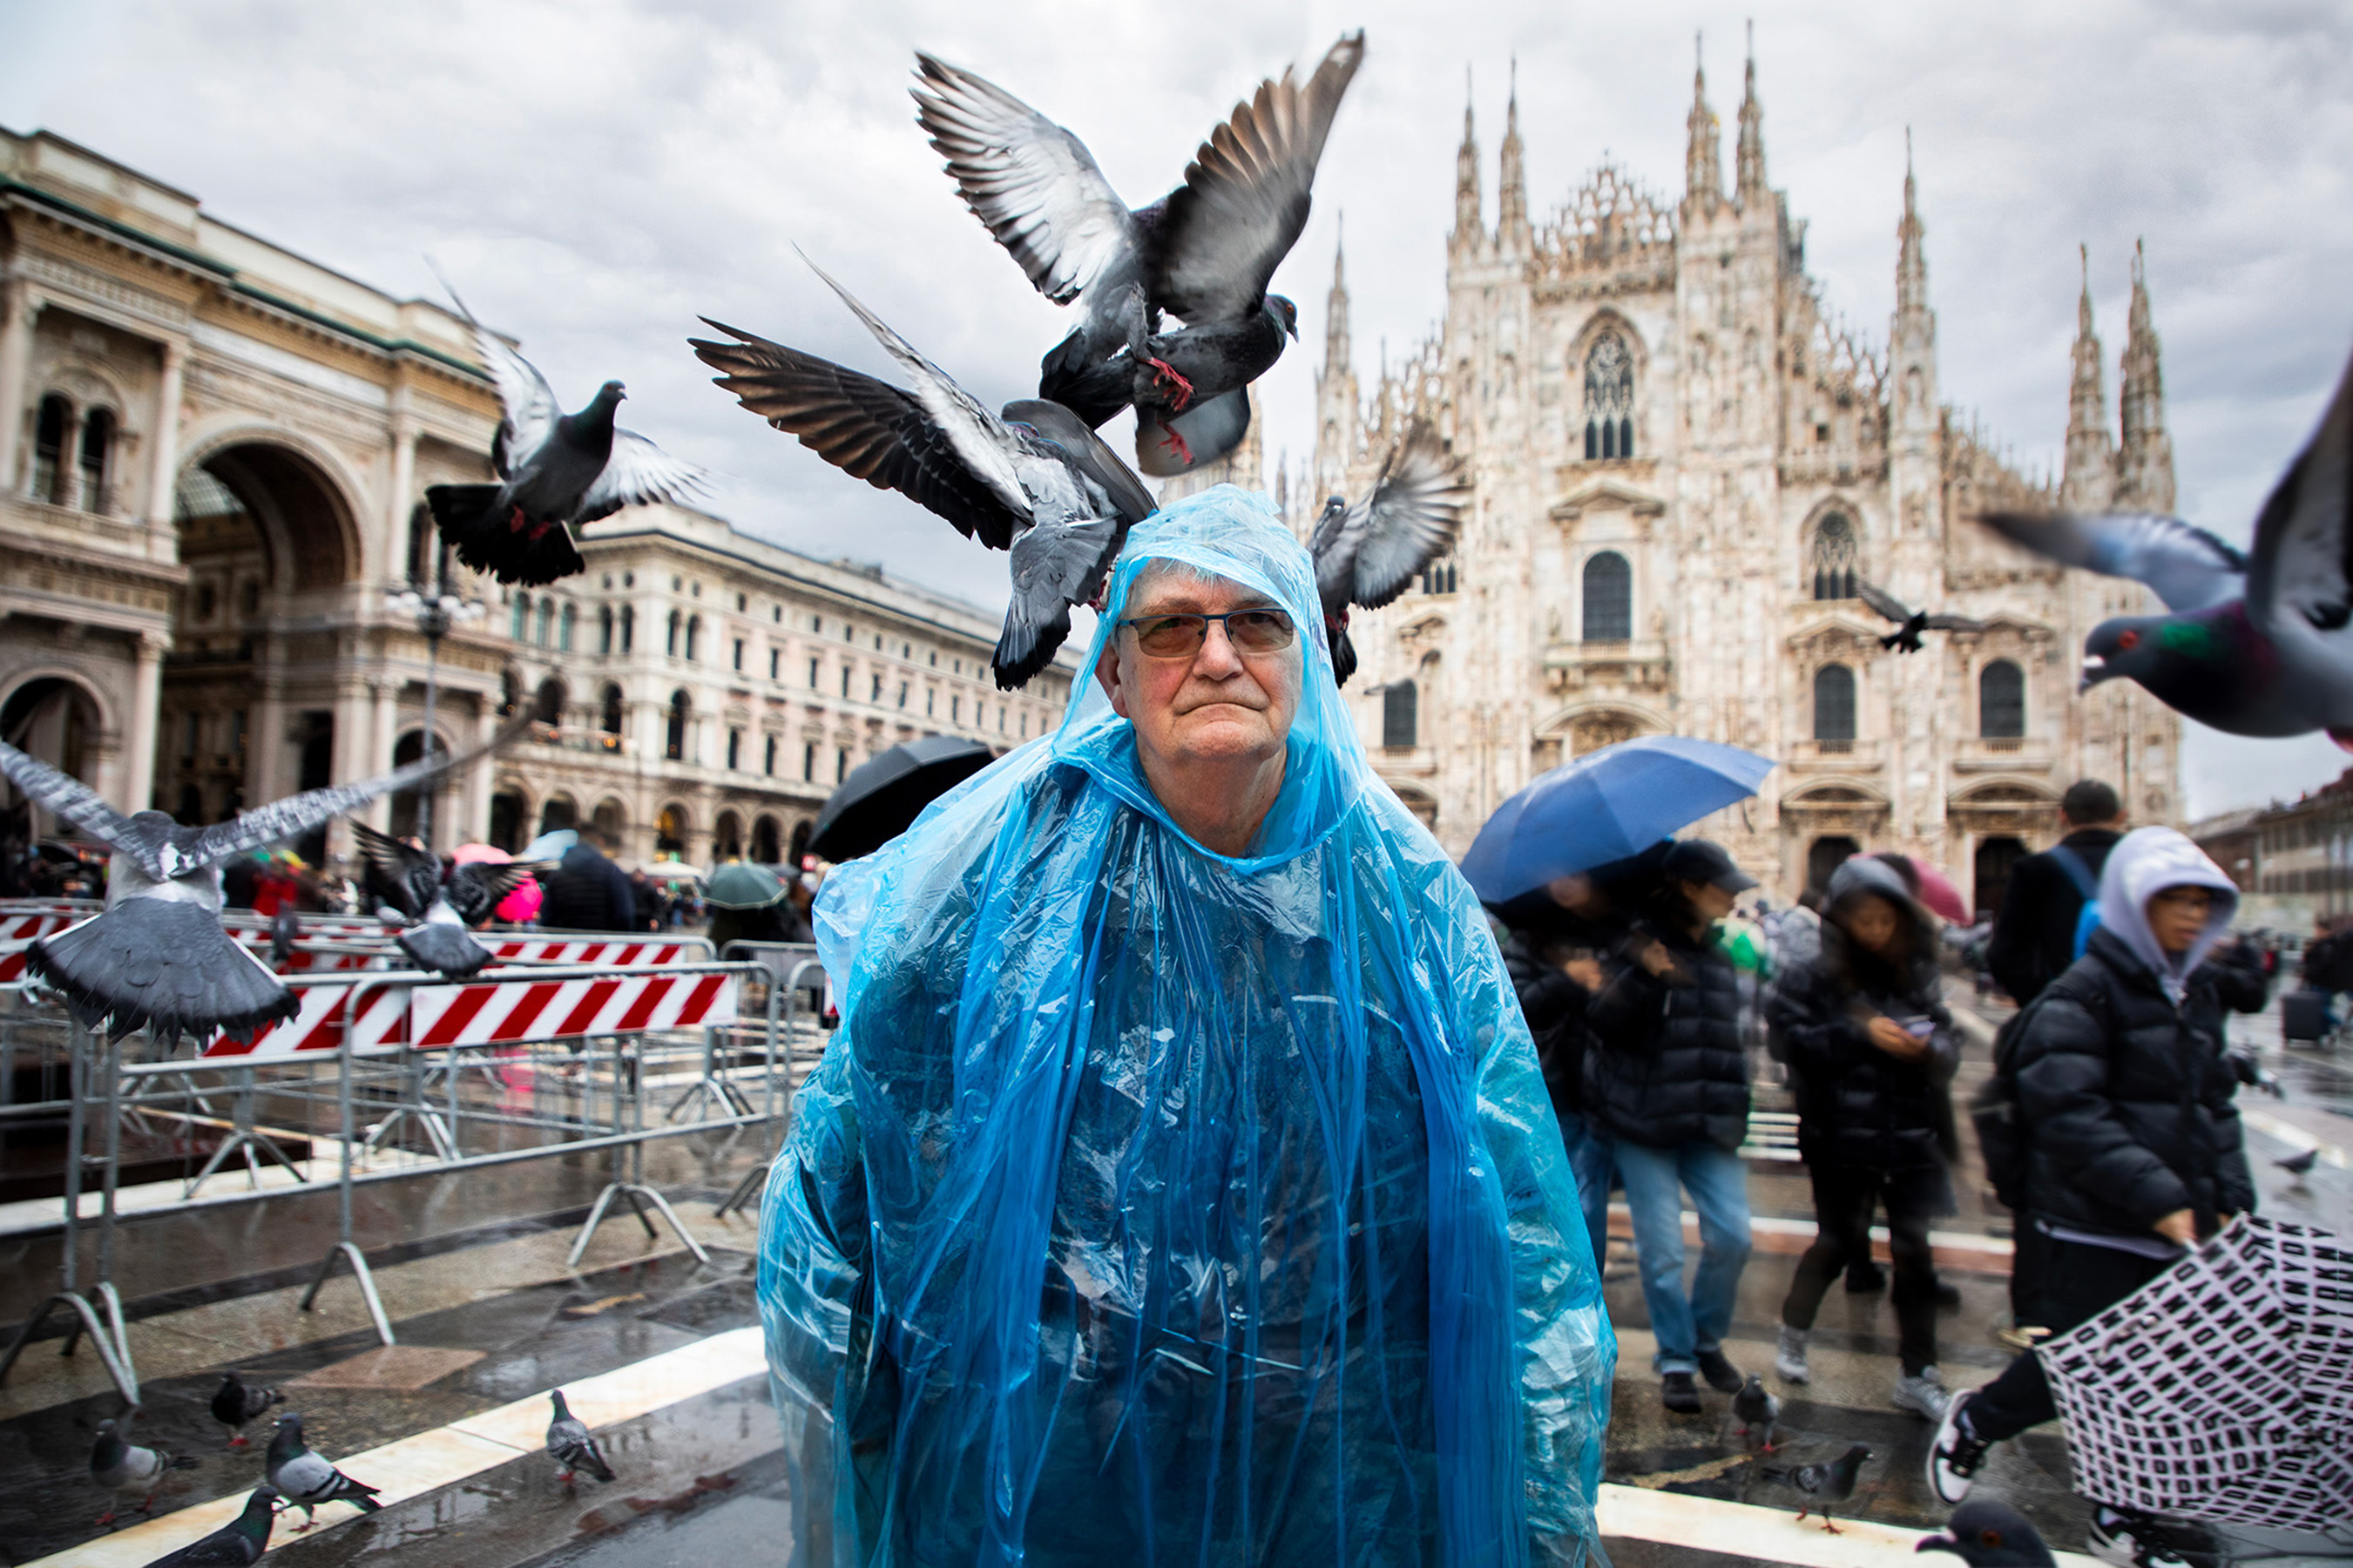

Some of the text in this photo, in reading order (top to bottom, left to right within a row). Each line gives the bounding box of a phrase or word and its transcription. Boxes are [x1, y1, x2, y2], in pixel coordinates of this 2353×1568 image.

[2148, 1281, 2218, 1345] DKNY
[2187, 1281, 2257, 1344] DKNY
[2150, 1329, 2218, 1389] DKNY
[2123, 1419, 2196, 1438] DKNY
[2189, 1424, 2262, 1455] DKNY
[2110, 1434, 2185, 1455] DKNY
[2153, 1455, 2228, 1475] DKNY
